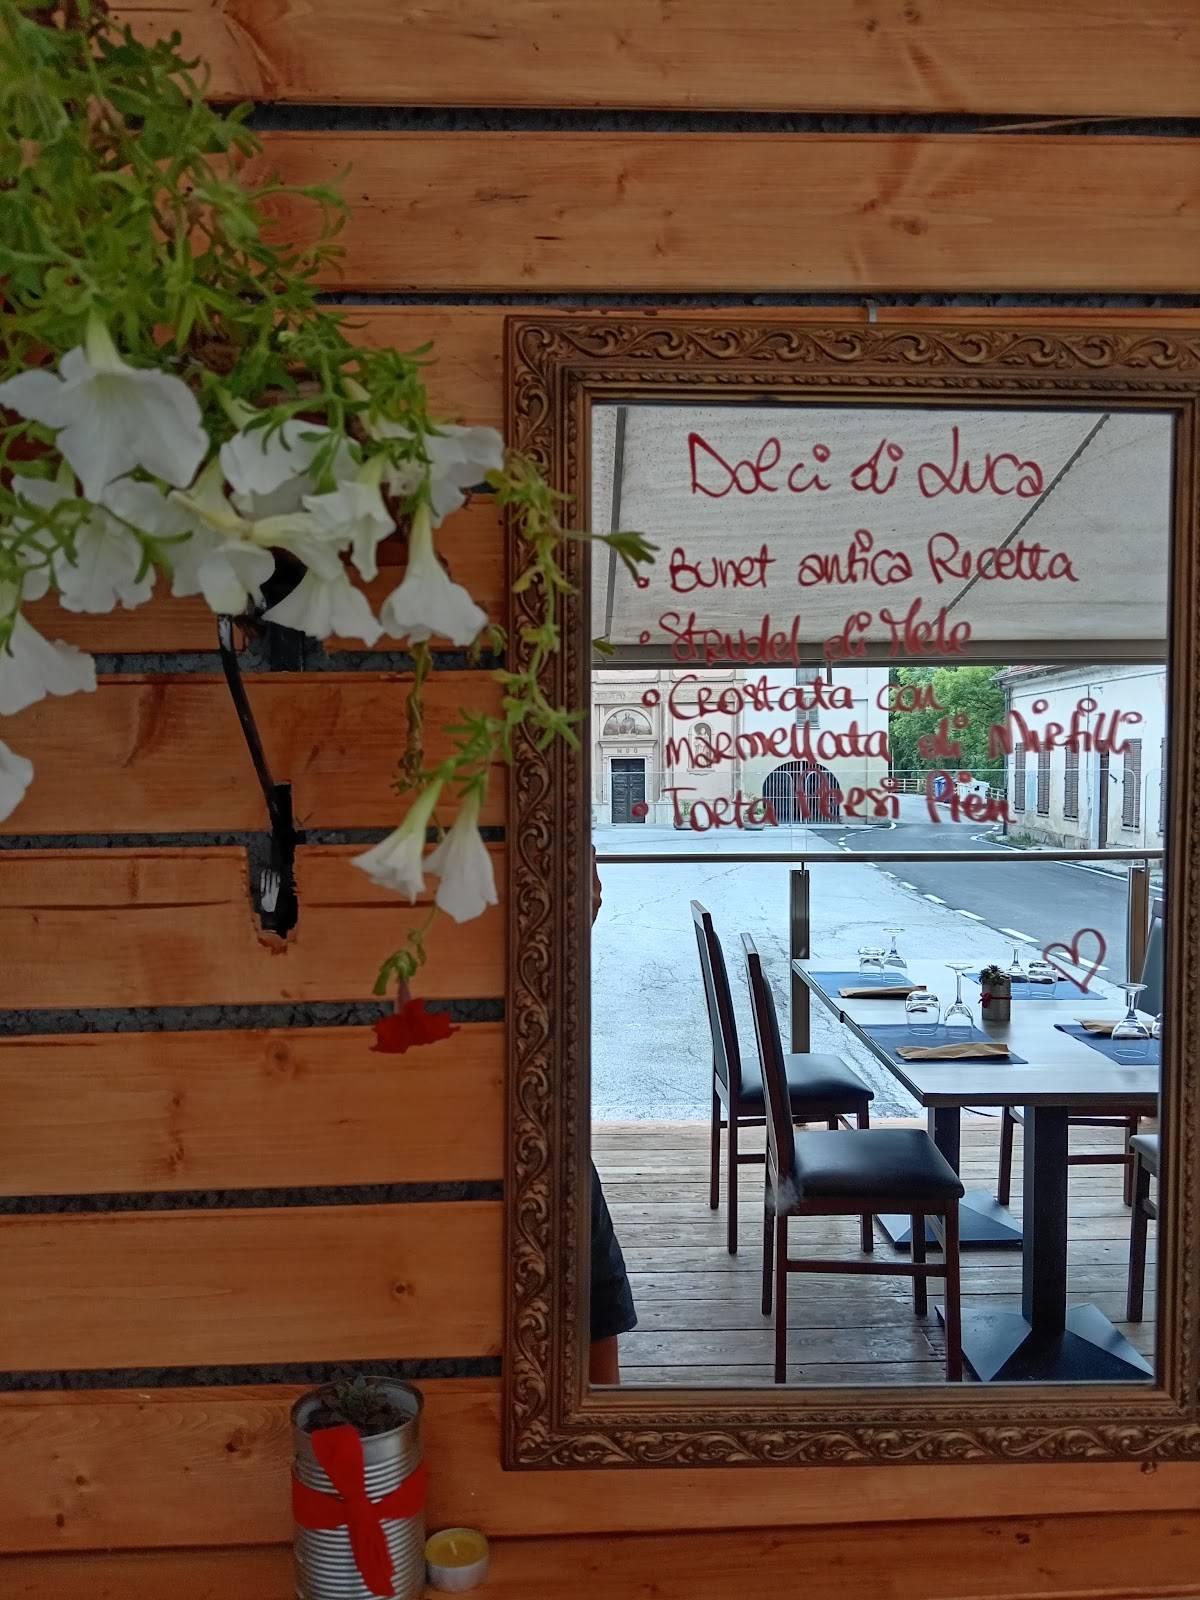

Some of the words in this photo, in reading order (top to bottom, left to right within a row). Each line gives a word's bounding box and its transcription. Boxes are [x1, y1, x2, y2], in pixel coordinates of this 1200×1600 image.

[688, 432, 831, 498] Dolci
[850, 438, 904, 495] di
[918, 426, 1043, 498] Luca
[669, 544, 777, 593] Bunet
[928, 532, 1079, 584] Ricetta
[659, 612, 800, 666] Strudel
[824, 612, 872, 661] di
